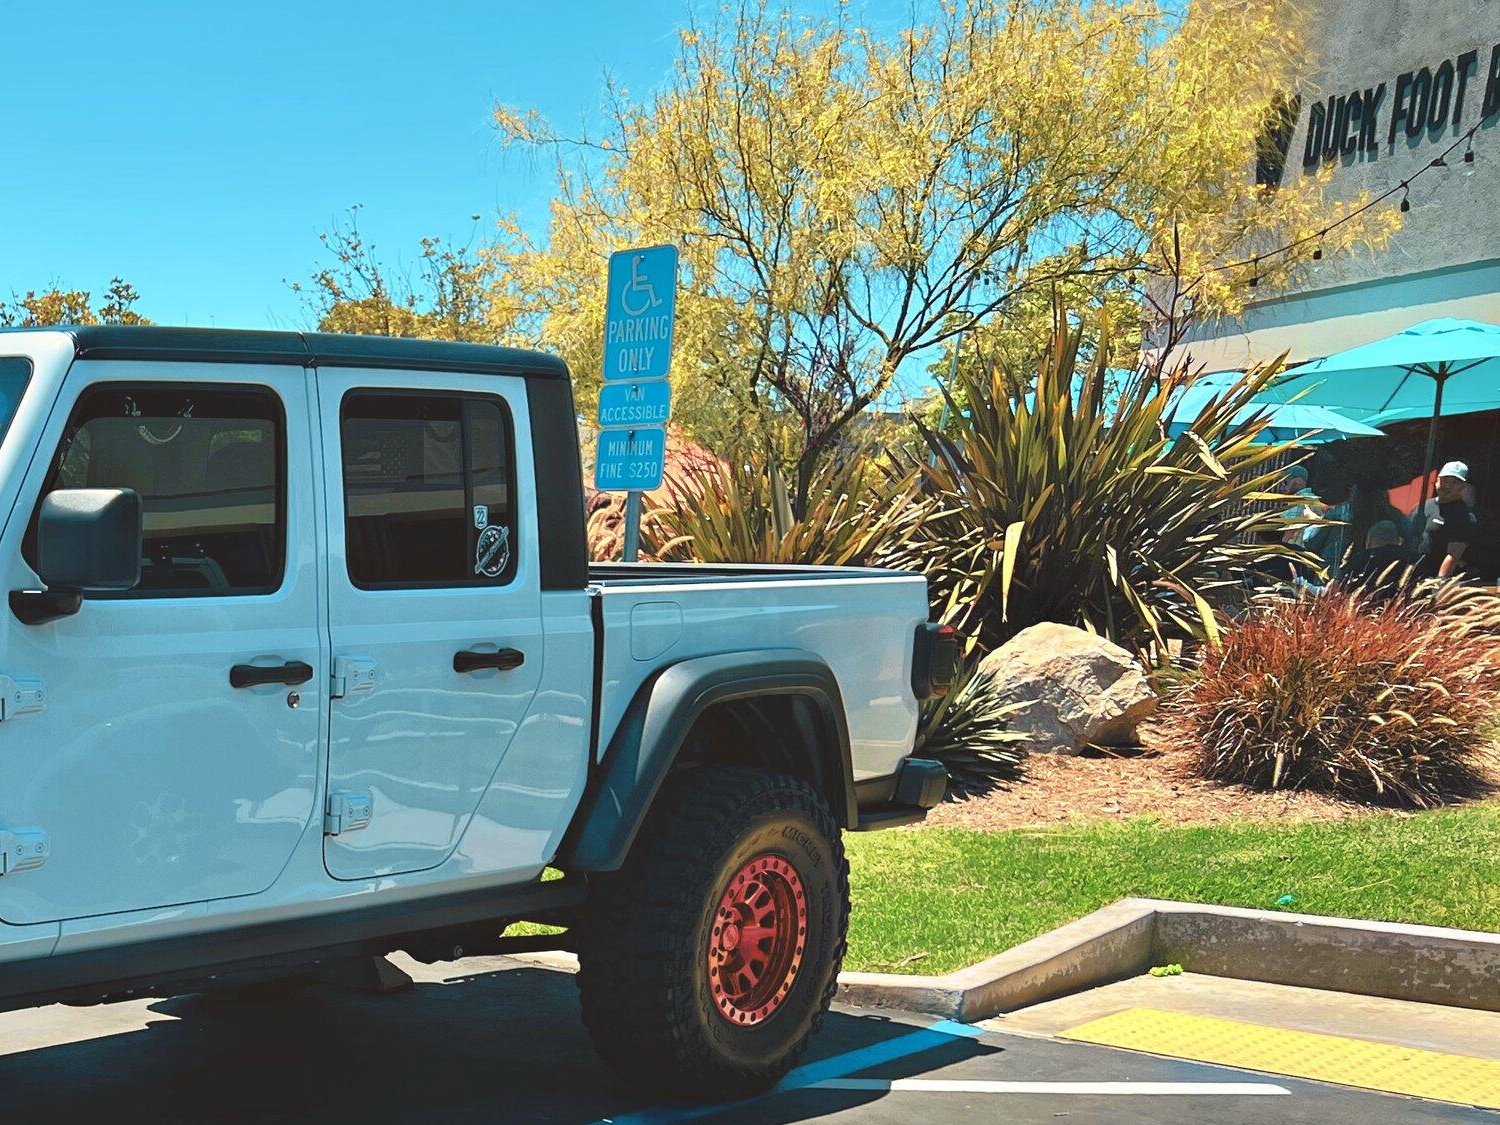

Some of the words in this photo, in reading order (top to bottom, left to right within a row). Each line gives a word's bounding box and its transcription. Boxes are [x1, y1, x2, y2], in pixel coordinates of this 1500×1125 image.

[1303, 82, 1387, 168] DUCK
[1388, 49, 1478, 144] FOOT
[608, 315, 670, 344] PARKING
[618, 347, 655, 373] ONLY
[624, 388, 645, 402] VAN
[601, 404, 666, 422] ACCESSIBLE
[608, 440, 653, 457] MINIMUM
[601, 463, 623, 479] FINE
[629, 462, 658, 479] $250
